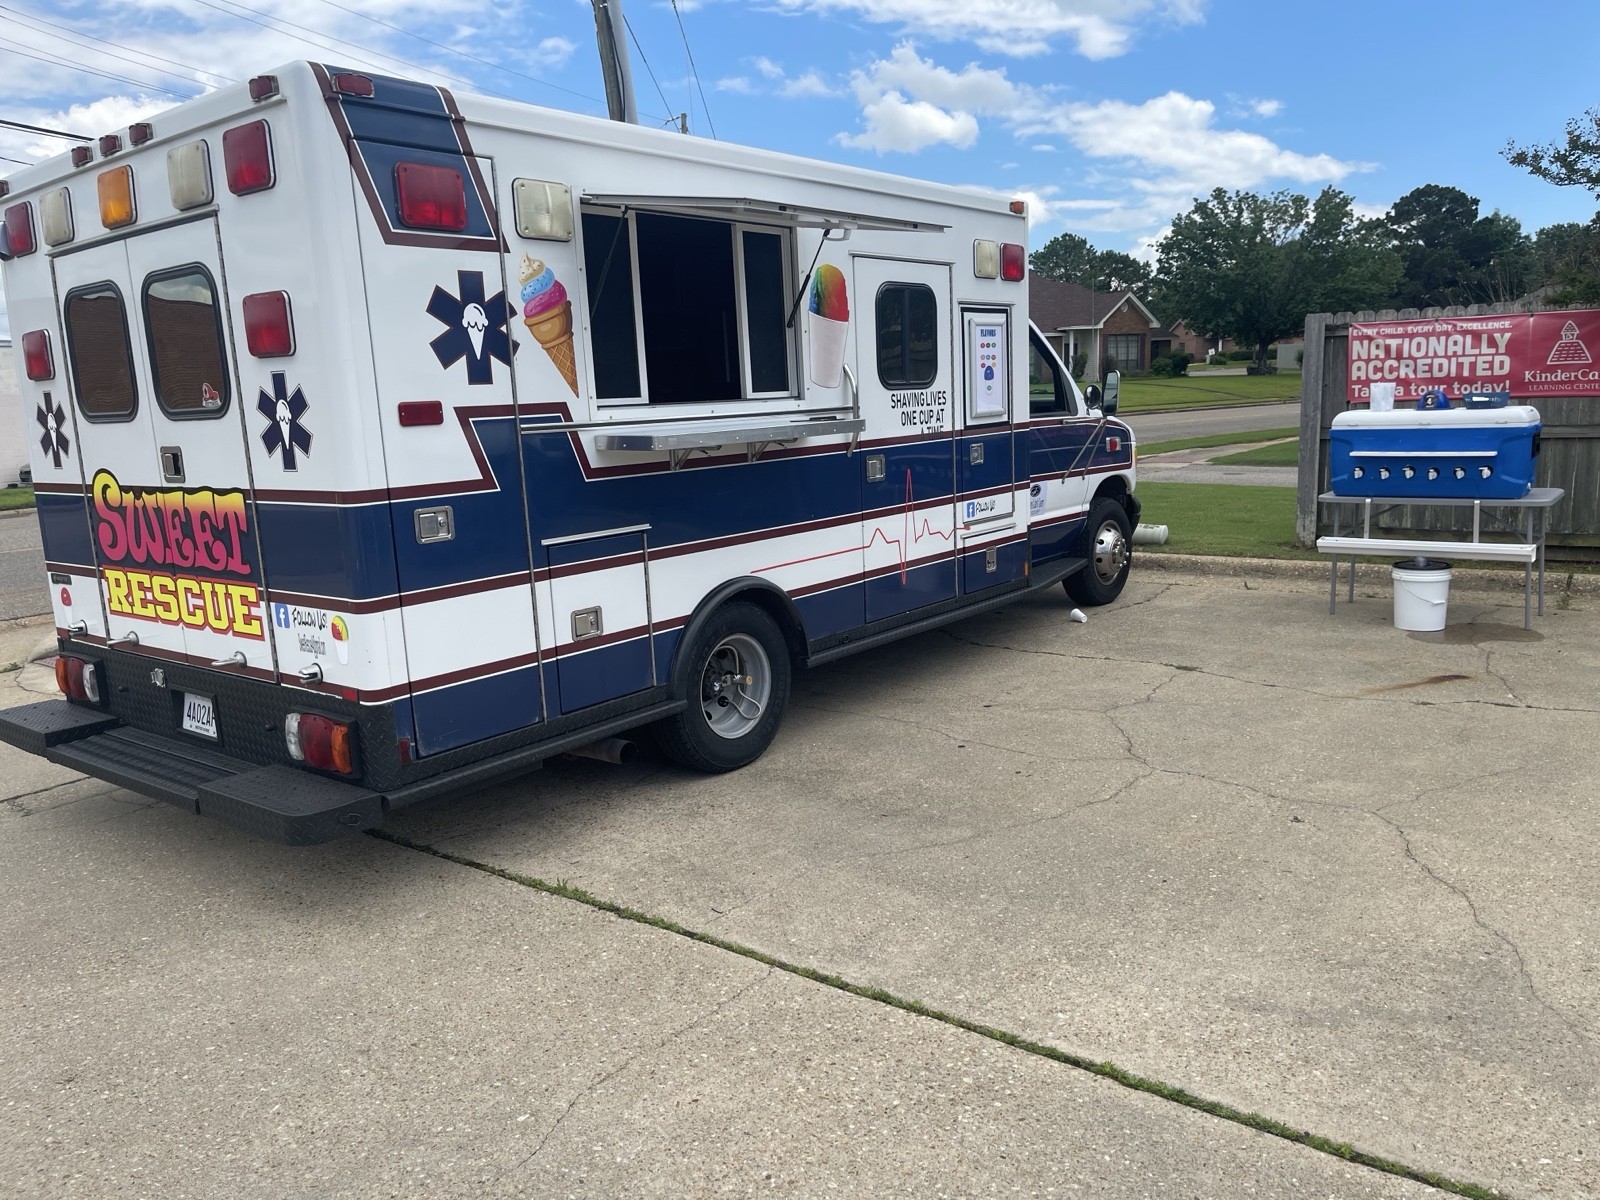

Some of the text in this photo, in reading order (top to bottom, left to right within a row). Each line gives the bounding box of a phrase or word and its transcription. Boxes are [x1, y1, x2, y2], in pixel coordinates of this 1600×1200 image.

[980, 328, 997, 338] FLAVORS
[1353, 321, 1513, 336] EVERY CHILD. EVERY DAY. EXCELLENCE.
[1352, 332, 1512, 360] NATIONALLY
[1352, 355, 1510, 381] ACCREDITED
[1395, 385, 1404, 396] a
[1410, 383, 1447, 395] tour
[1453, 380, 1510, 395] today!
[891, 391, 946, 409] SHAVING LIVES
[901, 408, 945, 426] ONE CUP AT
[92, 468, 251, 575] SWEET
[104, 566, 264, 639] RESCUE
